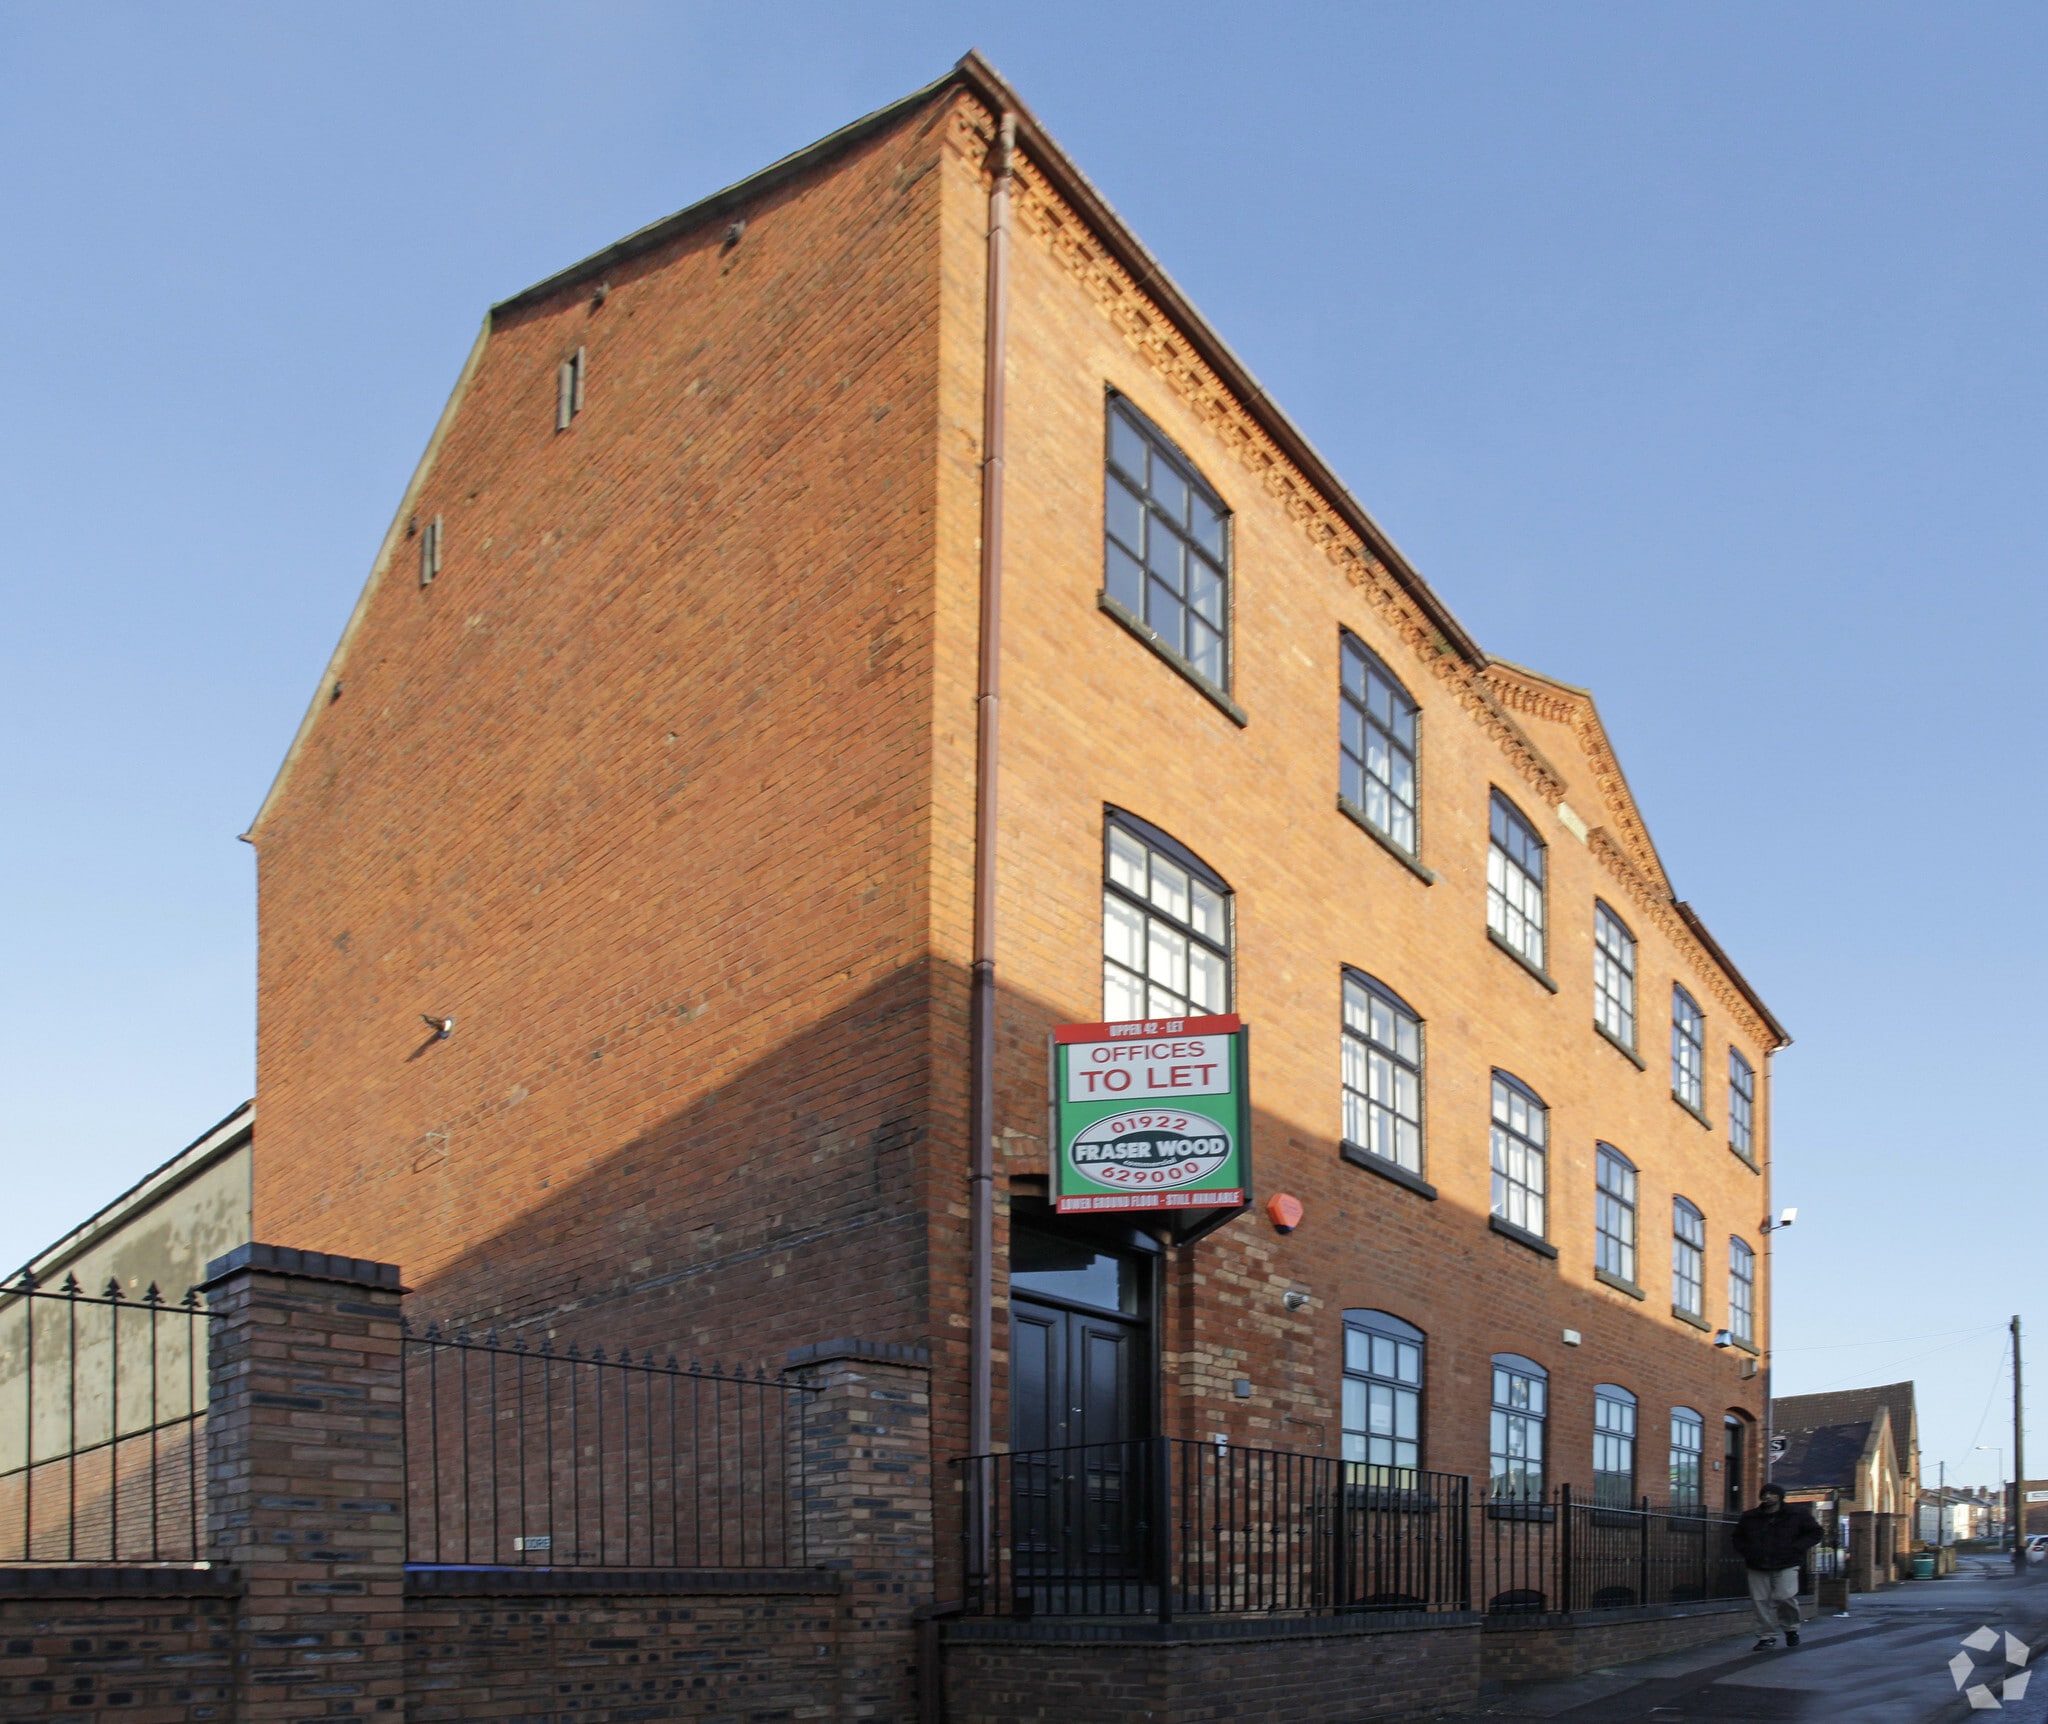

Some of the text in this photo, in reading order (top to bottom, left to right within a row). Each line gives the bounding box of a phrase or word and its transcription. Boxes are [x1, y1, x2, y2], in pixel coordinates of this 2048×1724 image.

[1109, 1023, 1142, 1037] UPPER
[1143, 1022, 1159, 1034] 42
[1166, 1020, 1185, 1033] LET
[1091, 1041, 1205, 1063] OFFICES
[1079, 1063, 1218, 1093] TO LET
[1111, 1116, 1188, 1134] 01922
[1075, 1138, 1226, 1161] FRASER WOOD
[1101, 1162, 1199, 1183] 629000
[1061, 1198, 1091, 1210] LOWER
[1093, 1196, 1129, 1209] GROUND
[1131, 1194, 1159, 1207] FLOOR
[1166, 1193, 1190, 1206] STILL
[1191, 1191, 1240, 1205] AVAILABLE
